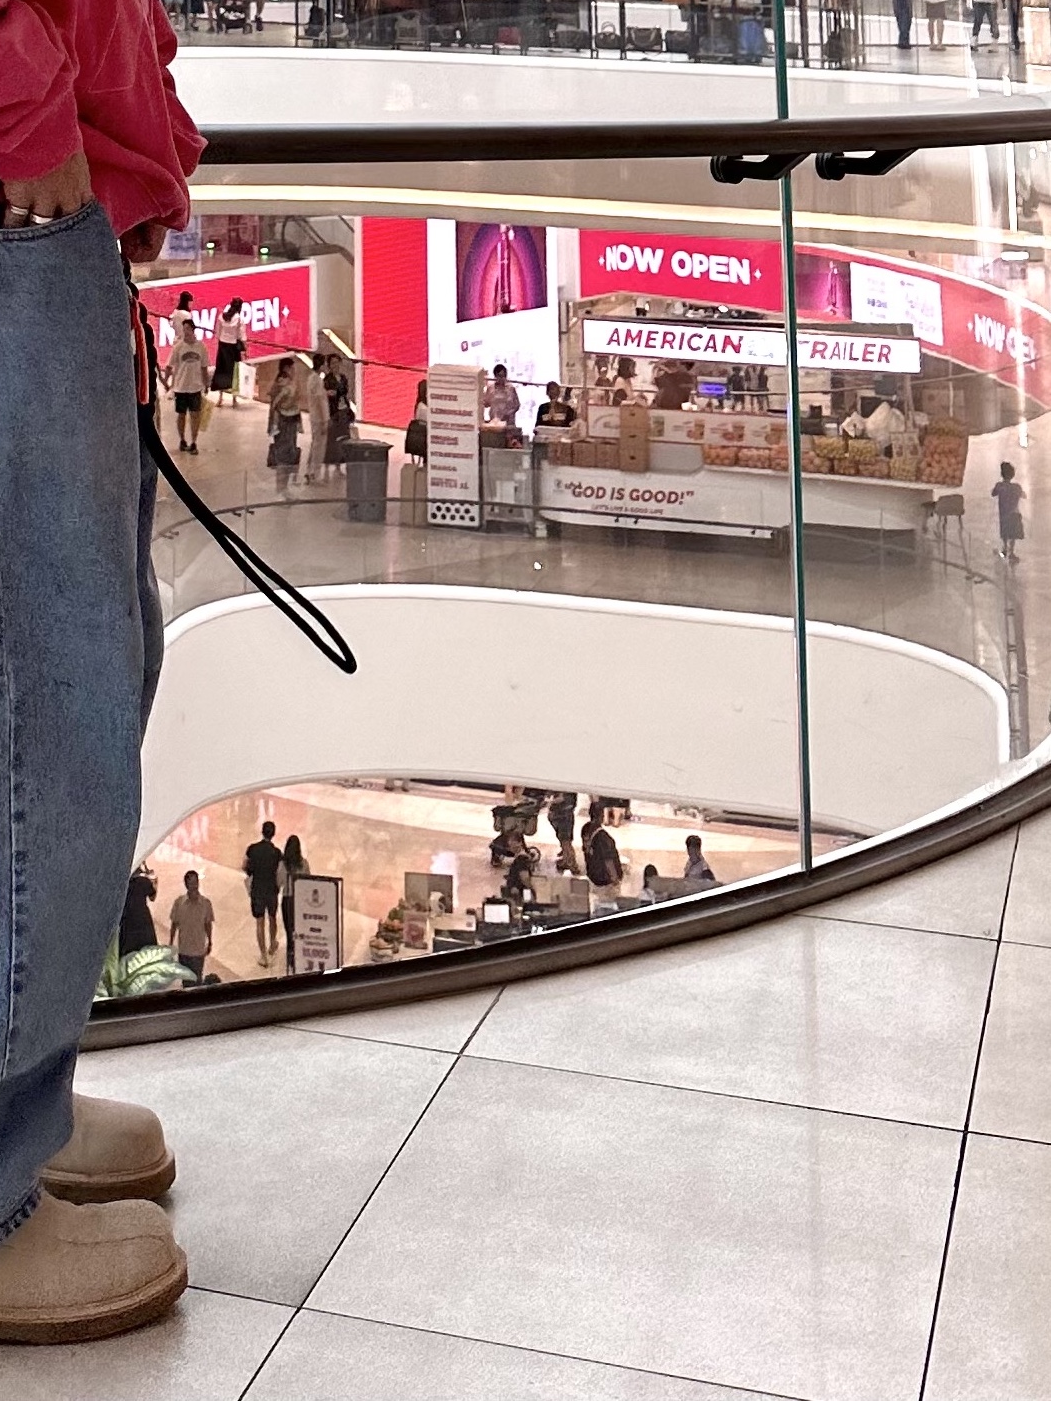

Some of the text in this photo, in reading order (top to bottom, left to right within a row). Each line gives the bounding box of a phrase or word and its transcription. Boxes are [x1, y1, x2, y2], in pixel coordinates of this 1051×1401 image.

[605, 244, 750, 285] NOW OPEN
[159, 297, 280, 347] NW PEN
[606, 328, 744, 354] AMERICAN
[974, 313, 1006, 353] NOW
[610, 487, 625, 500] IS
